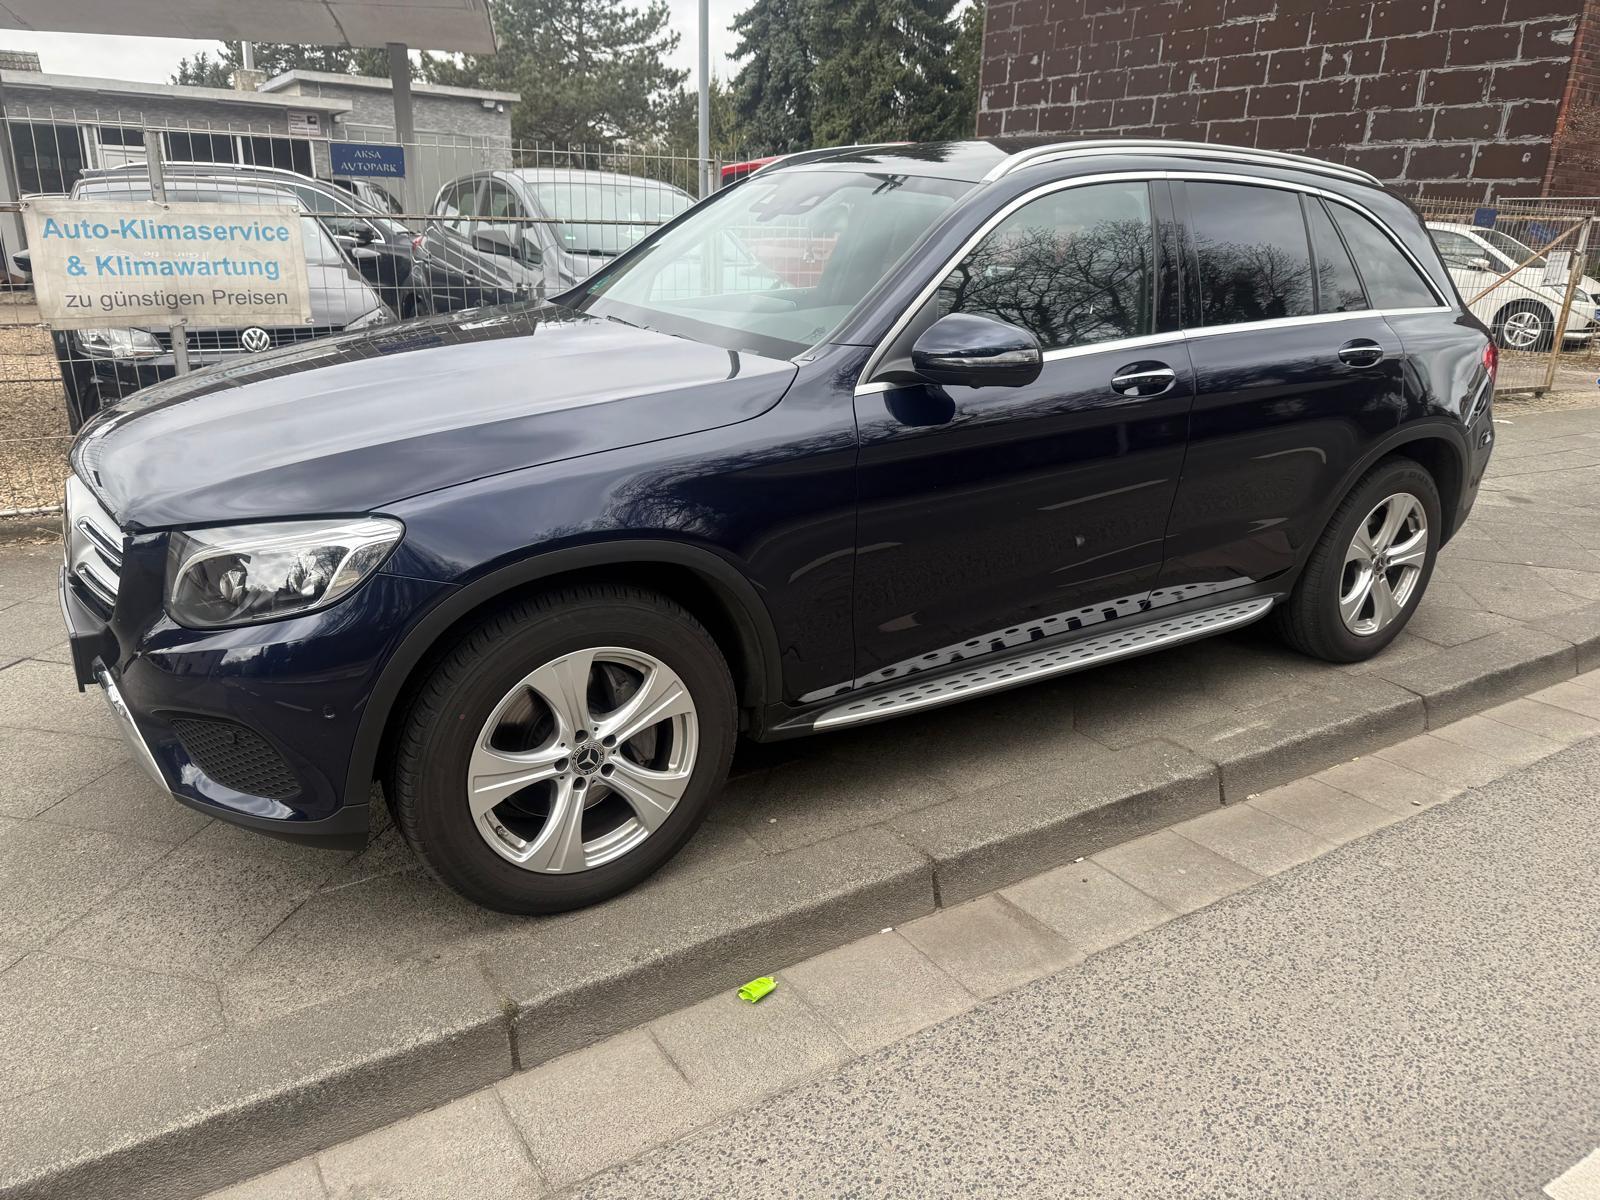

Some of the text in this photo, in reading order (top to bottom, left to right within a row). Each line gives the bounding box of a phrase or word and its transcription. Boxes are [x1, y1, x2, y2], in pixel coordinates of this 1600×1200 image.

[354, 150, 381, 159] AKSA
[42, 218, 289, 241] Auto-Klimaservice
[67, 255, 280, 280] & Klimawartung
[65, 289, 288, 311] zu günstigen Preisen
